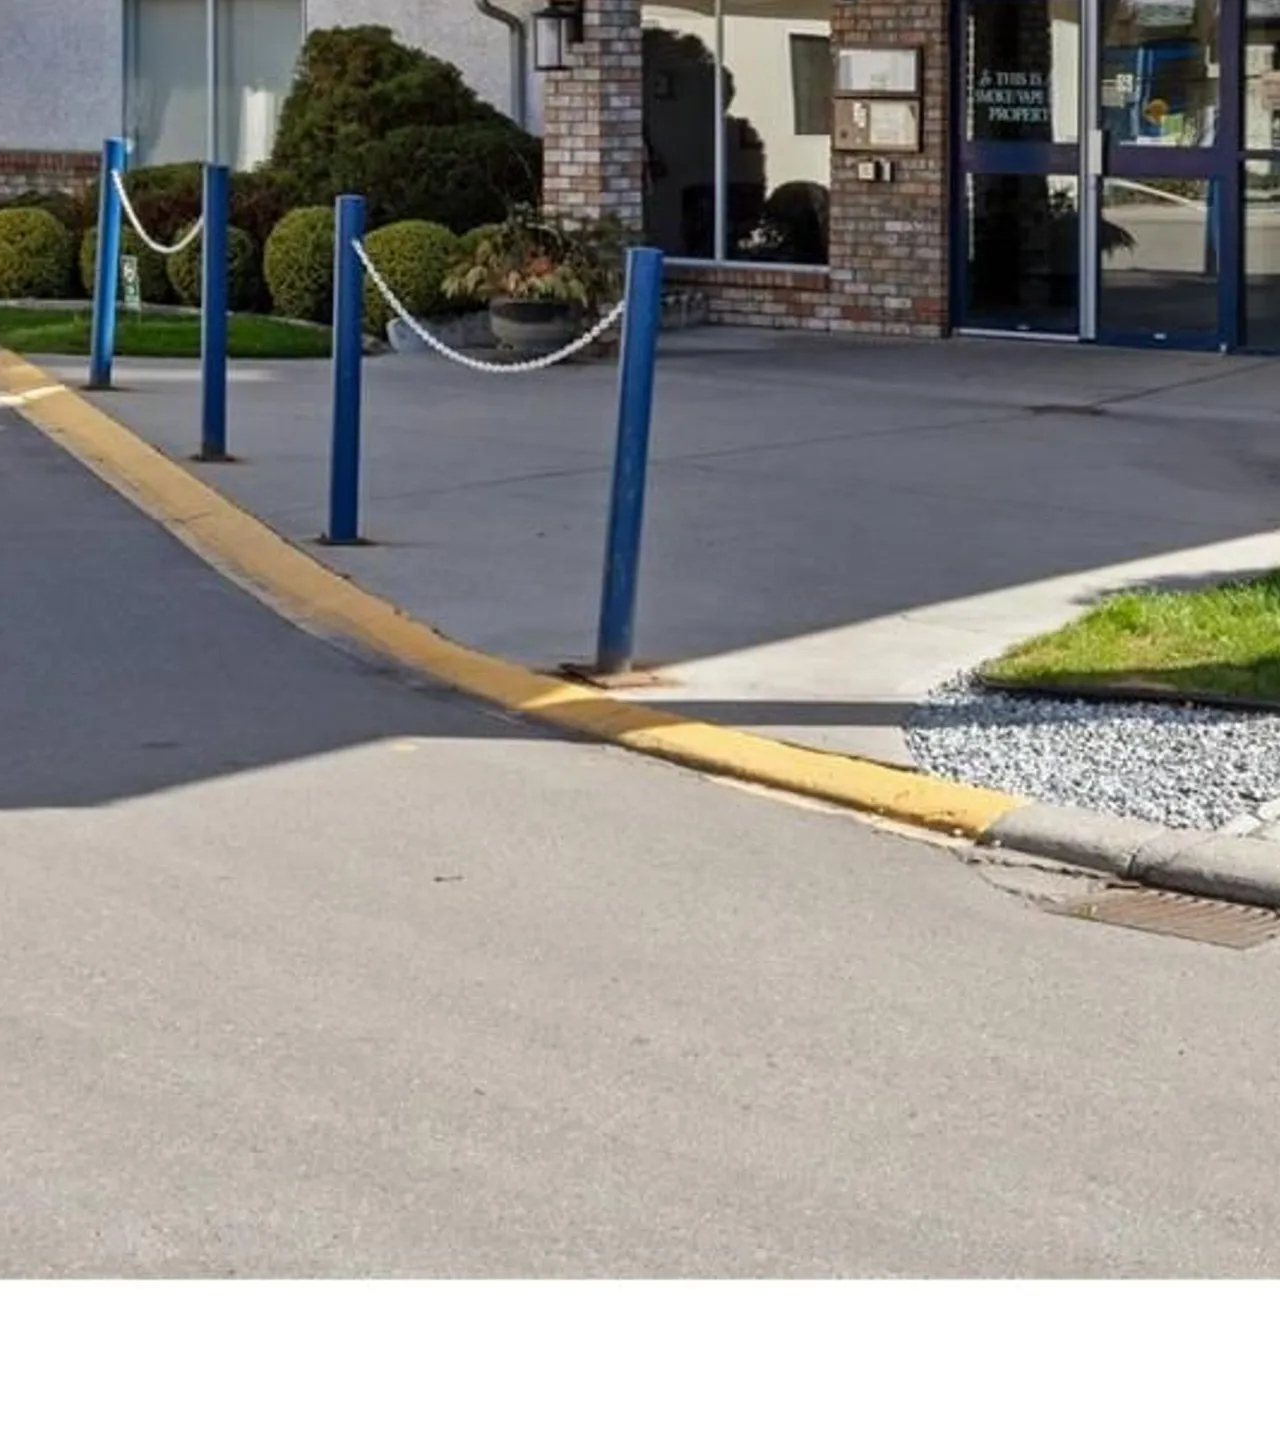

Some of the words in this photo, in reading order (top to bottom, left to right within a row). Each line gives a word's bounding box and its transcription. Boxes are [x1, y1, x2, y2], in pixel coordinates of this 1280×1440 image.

[996, 71, 1027, 86] THIS
[1029, 71, 1043, 86] IS
[988, 106, 1049, 122] PROPERT
